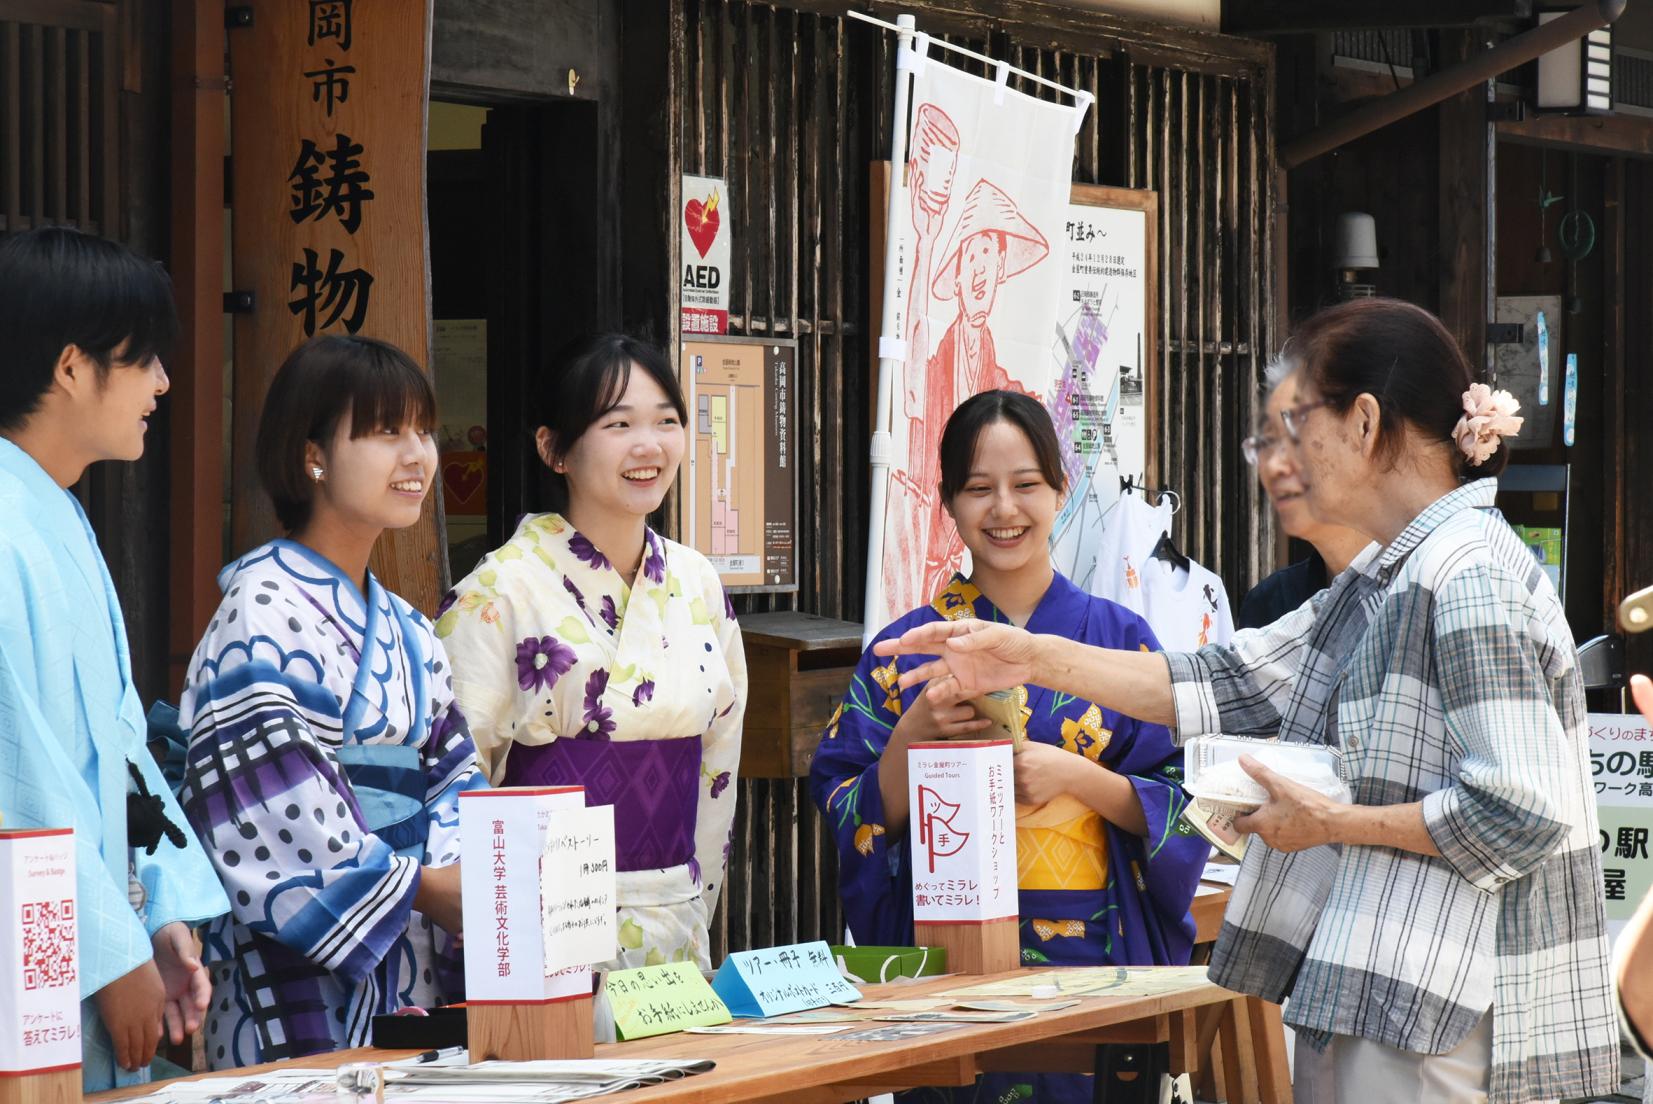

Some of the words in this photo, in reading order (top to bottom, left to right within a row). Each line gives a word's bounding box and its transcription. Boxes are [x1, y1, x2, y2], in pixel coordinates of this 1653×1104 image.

[287, 0, 375, 338] 岡市鋳物
[683, 264, 720, 289] AED
[945, 771, 961, 779] Tours
[938, 833, 950, 847] 手
[916, 894, 980, 907] 書いてミラレ!
[23, 1011, 64, 1025] アンケートに
